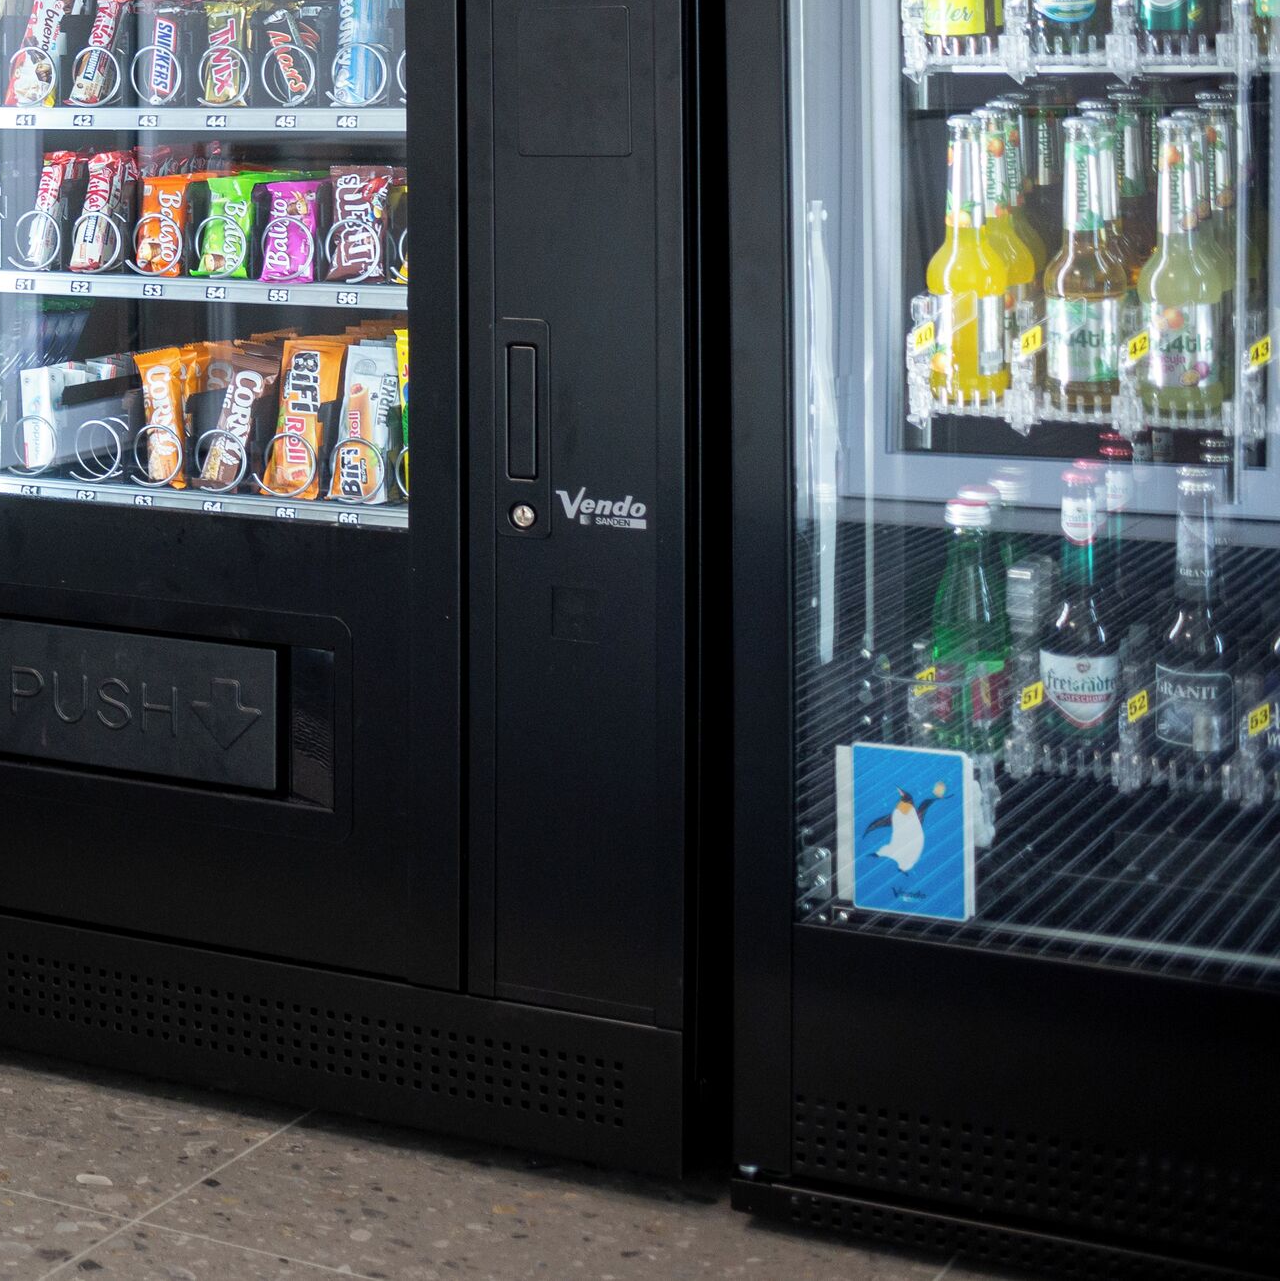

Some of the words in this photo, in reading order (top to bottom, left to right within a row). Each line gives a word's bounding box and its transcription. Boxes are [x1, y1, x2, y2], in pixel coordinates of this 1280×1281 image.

[42, 7, 60, 52] bueno
[154, 21, 174, 92] SNICKERS
[267, 30, 308, 93] Mars
[16, 114, 34, 125] 41
[73, 115, 92, 126] 42
[139, 115, 157, 127] 43
[207, 115, 226, 127] 44
[276, 115, 296, 127] 45
[337, 115, 357, 127] 46
[89, 171, 109, 213] KitKat
[266, 198, 290, 271] Balisto
[16, 279, 32, 289] 51
[72, 282, 90, 292] 52
[144, 285, 162, 296] 53
[207, 287, 226, 299] 54
[269, 290, 288, 301] 55
[338, 293, 357, 305] 56
[915, 328, 933, 349] 40
[1023, 332, 1038, 349] 41
[1129, 336, 1148, 356] 42
[1251, 341, 1270, 361] 43
[222, 385, 234, 408] BIG
[23, 486, 38, 495] 61
[77, 490, 95, 500] 62
[134, 495, 153, 506] 63
[203, 501, 222, 512] 64
[555, 486, 647, 519] Vendo
[276, 507, 295, 518] 65
[338, 513, 359, 524] 66
[595, 517, 631, 527] SANDEN
[9, 665, 179, 737] PUSH
[1023, 688, 1039, 704] 51
[1129, 697, 1146, 718] 52
[1249, 707, 1269, 730] 53
